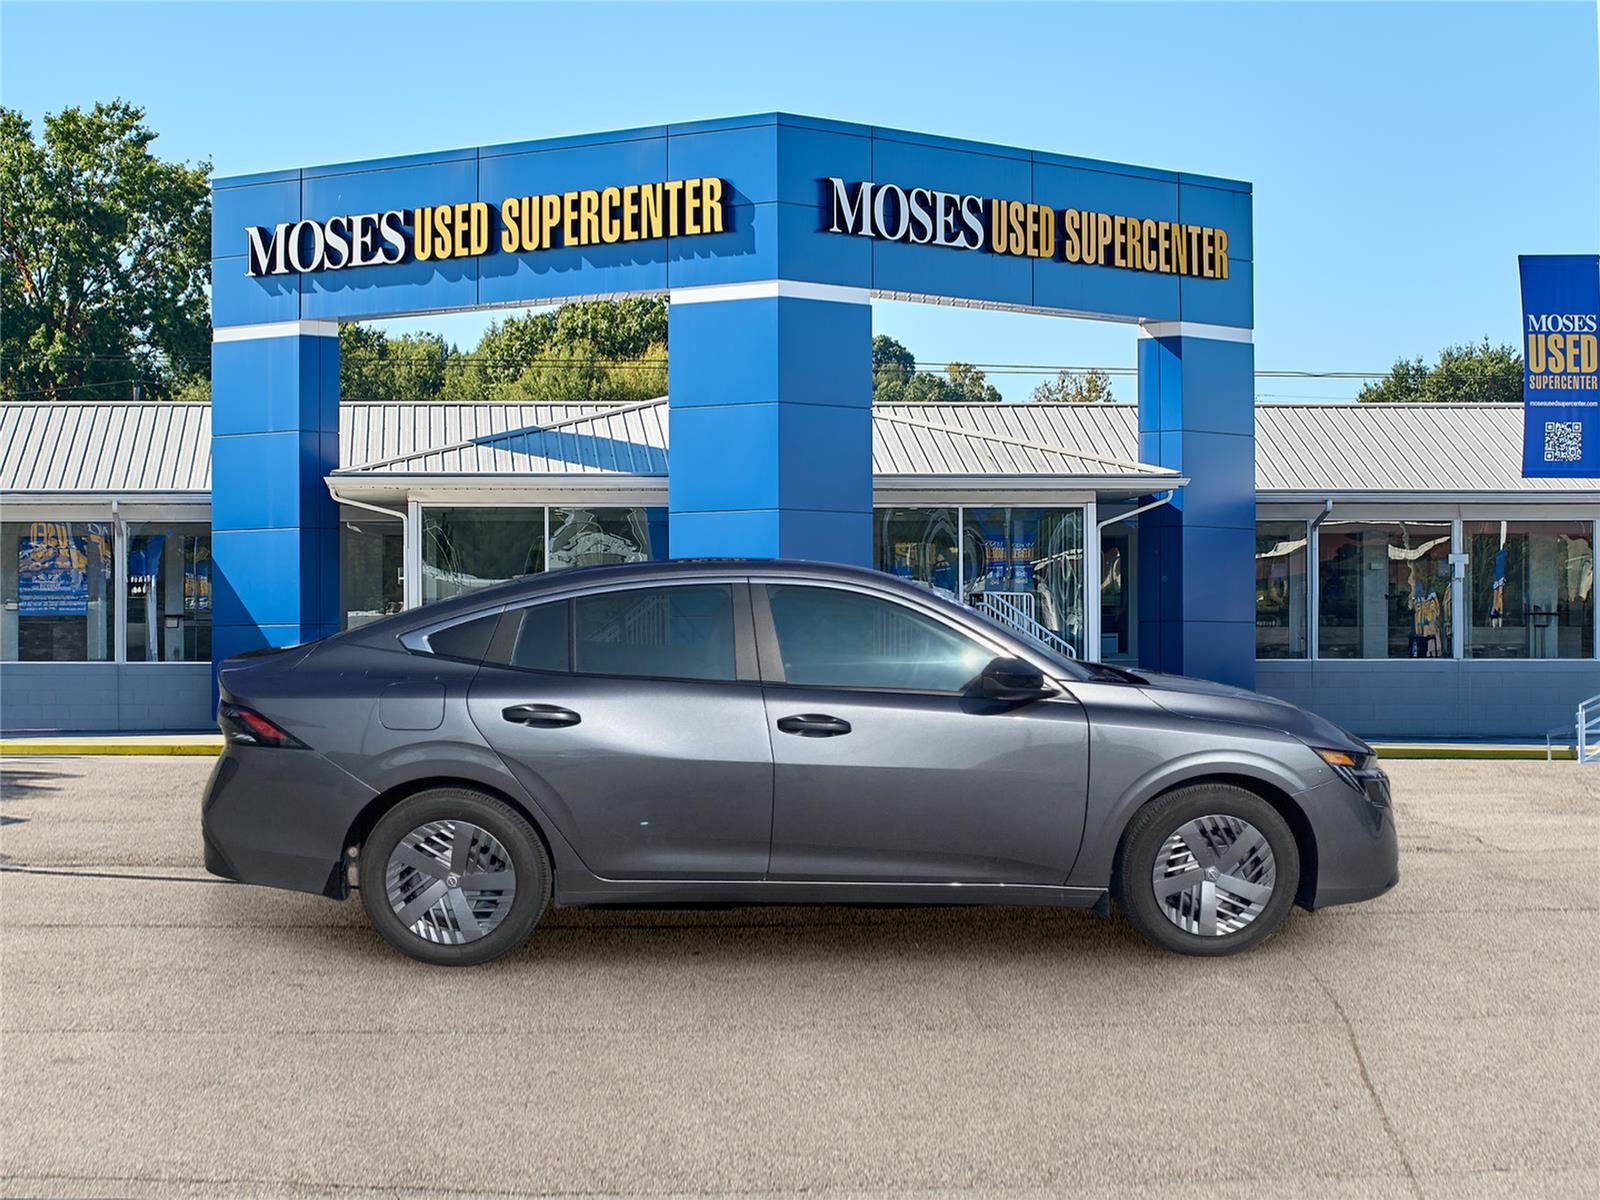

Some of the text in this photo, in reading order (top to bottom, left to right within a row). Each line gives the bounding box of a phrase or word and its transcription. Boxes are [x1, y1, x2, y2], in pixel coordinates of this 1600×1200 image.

[245, 177, 724, 277] MOSES USED SUPERCENTER
[829, 177, 1230, 280] MOSES USED SUPERCENTER
[1528, 314, 1597, 332] MOSES
[1528, 334, 1598, 373] USED
[1529, 375, 1598, 390] SUPERCENTER
